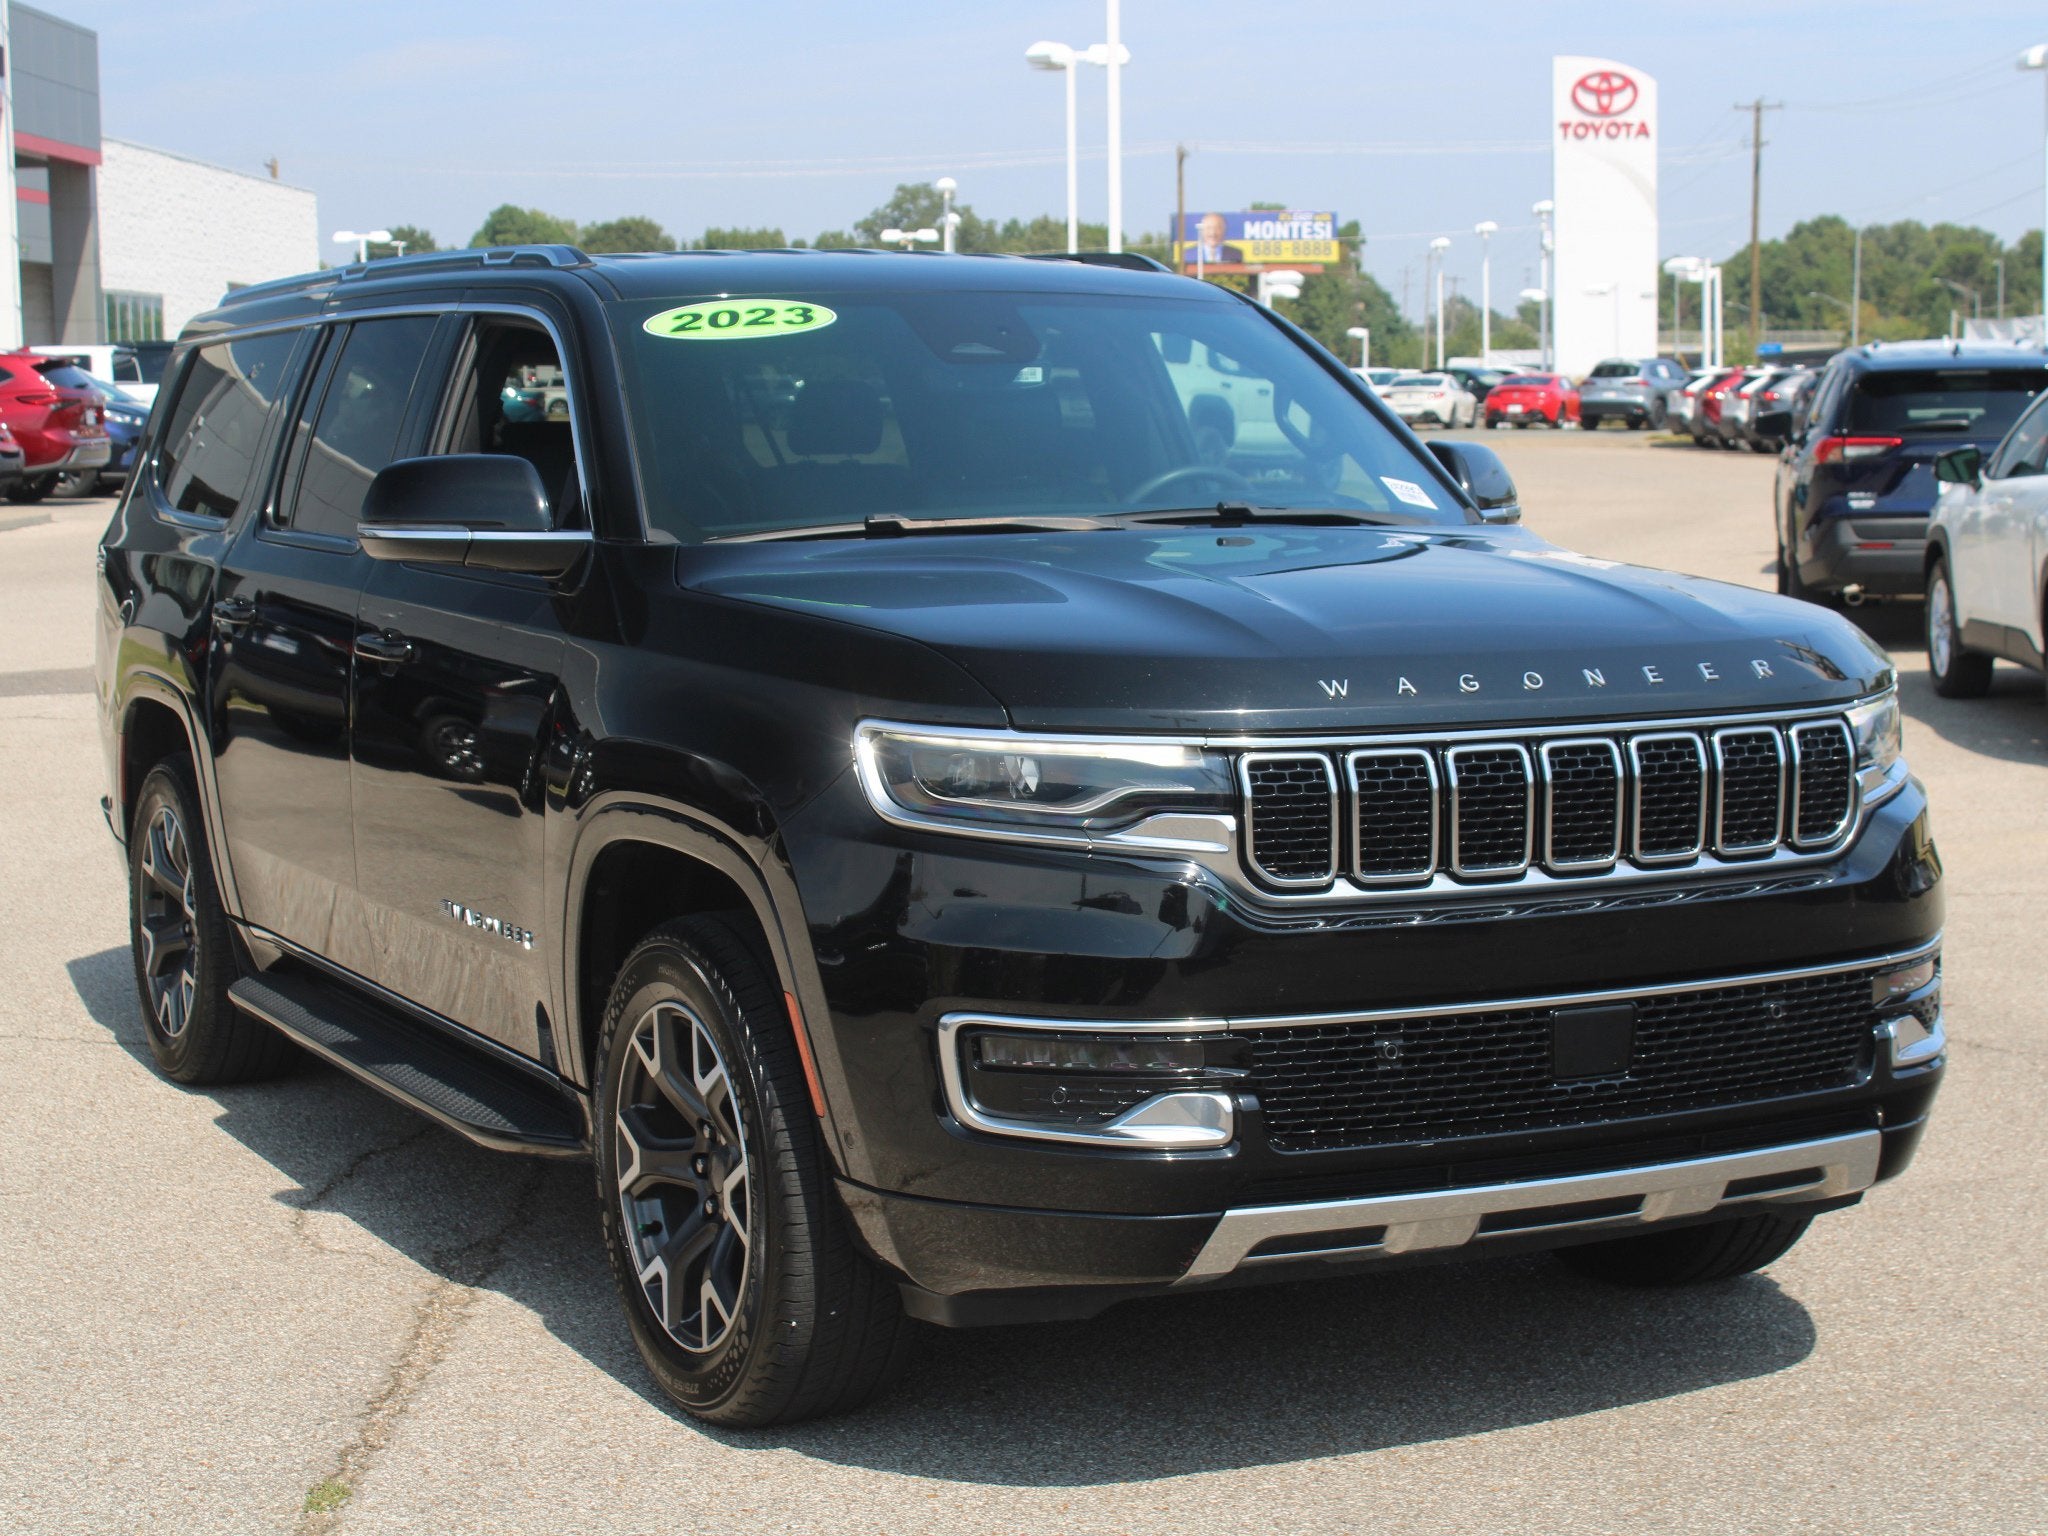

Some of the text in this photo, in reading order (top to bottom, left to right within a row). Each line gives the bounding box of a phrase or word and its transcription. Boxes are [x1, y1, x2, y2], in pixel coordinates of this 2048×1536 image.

[1559, 121, 1650, 140] TOYOTA
[1243, 220, 1333, 240] MONTESI
[670, 306, 815, 333] 2023
[1318, 658, 1775, 700] WAGONEER
